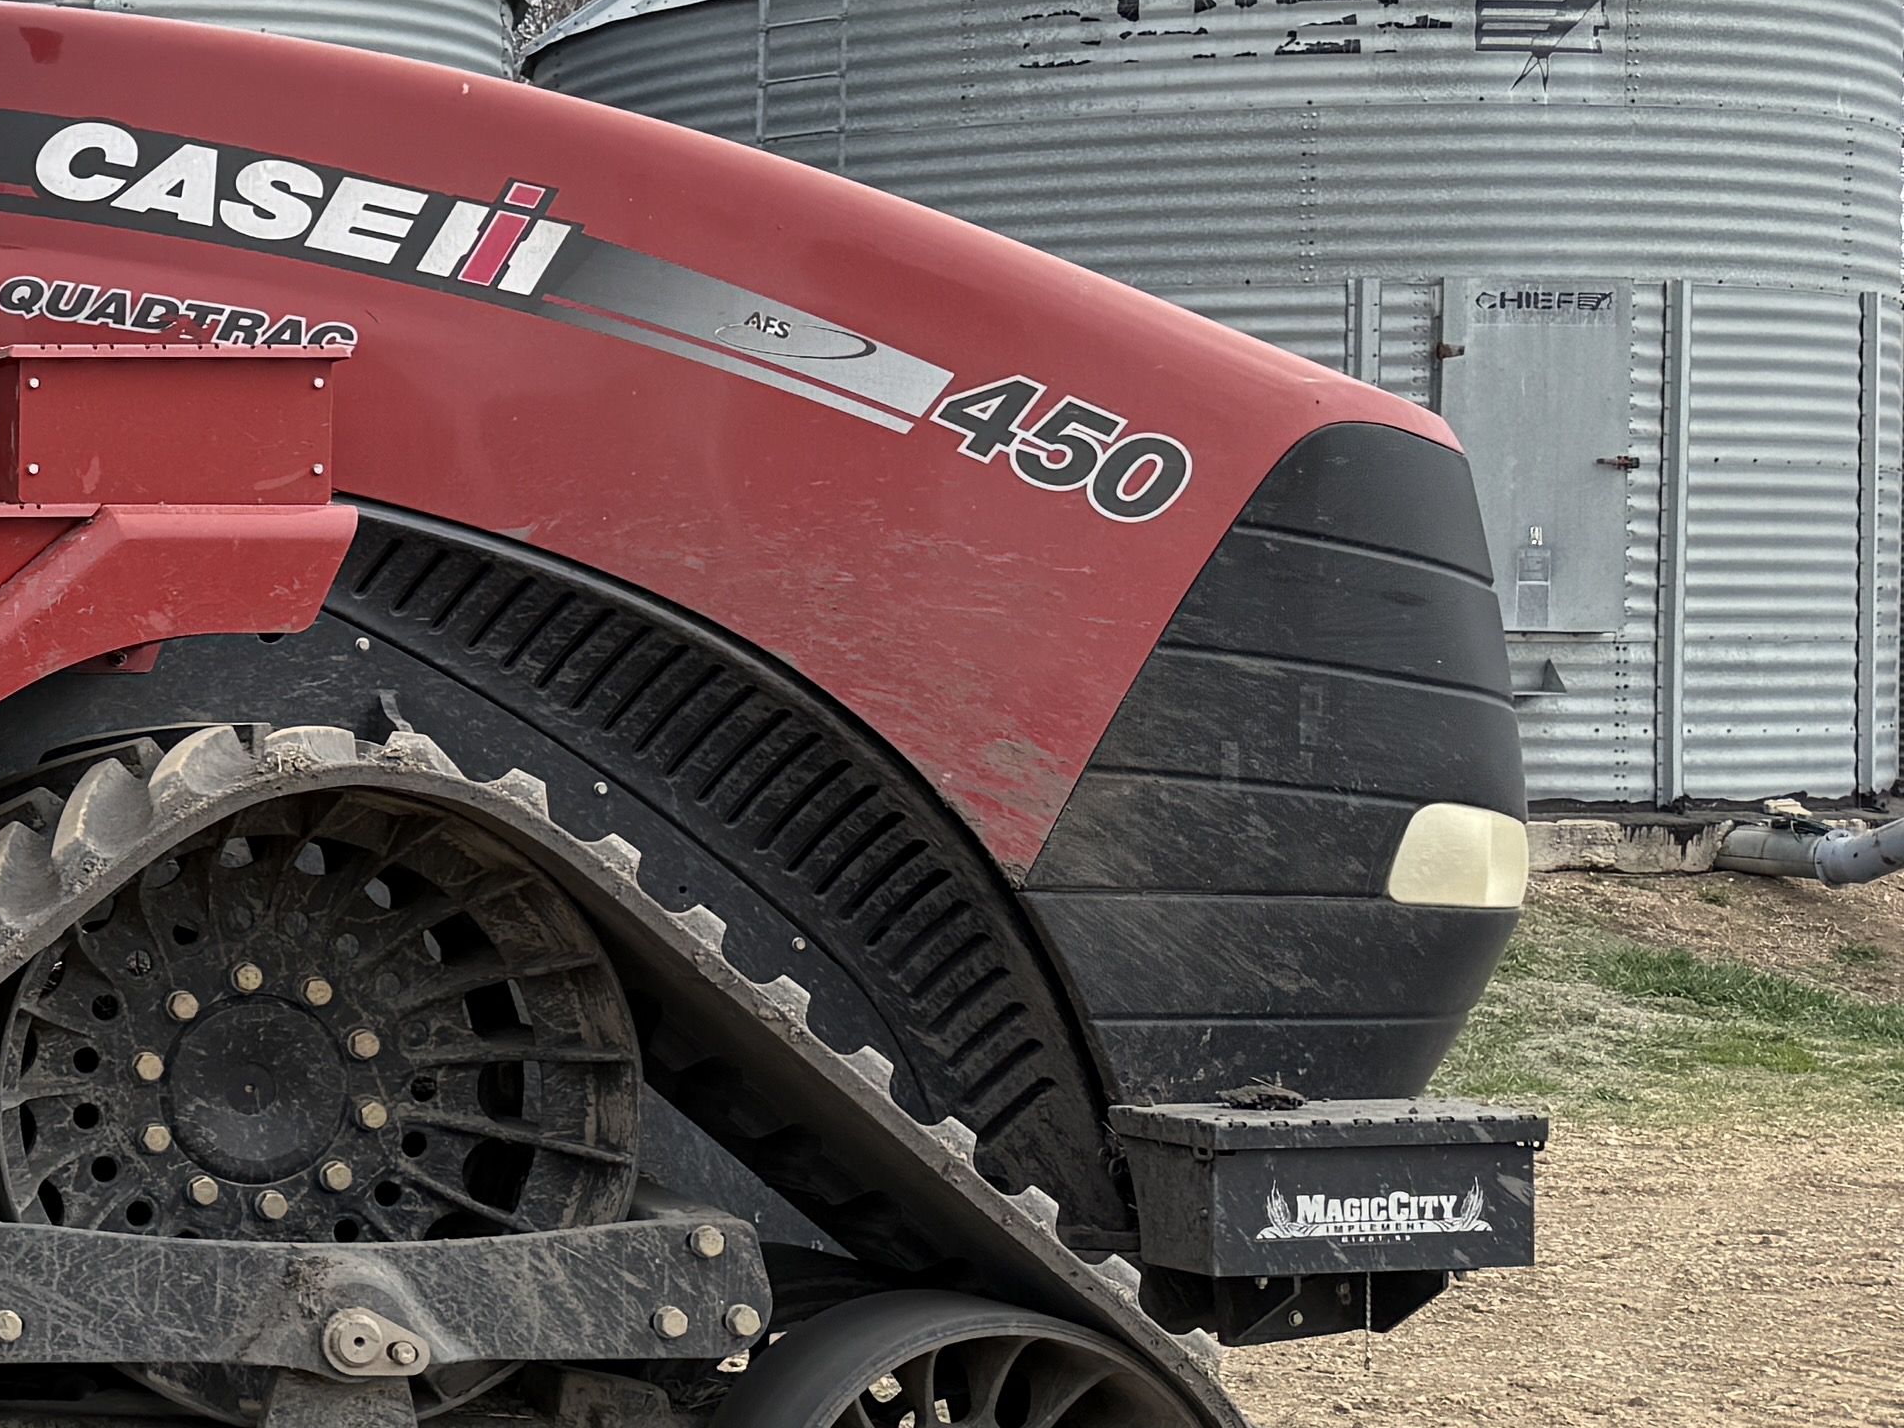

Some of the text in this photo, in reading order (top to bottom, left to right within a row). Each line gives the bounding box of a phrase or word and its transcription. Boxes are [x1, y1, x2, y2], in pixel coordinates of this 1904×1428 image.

[34, 122, 429, 264] CASE
[1475, 291, 1575, 310] CHIEF
[743, 311, 791, 339] AFS
[929, 374, 1193, 523] 450
[1325, 1222, 1426, 1233] IMPLEMENT
